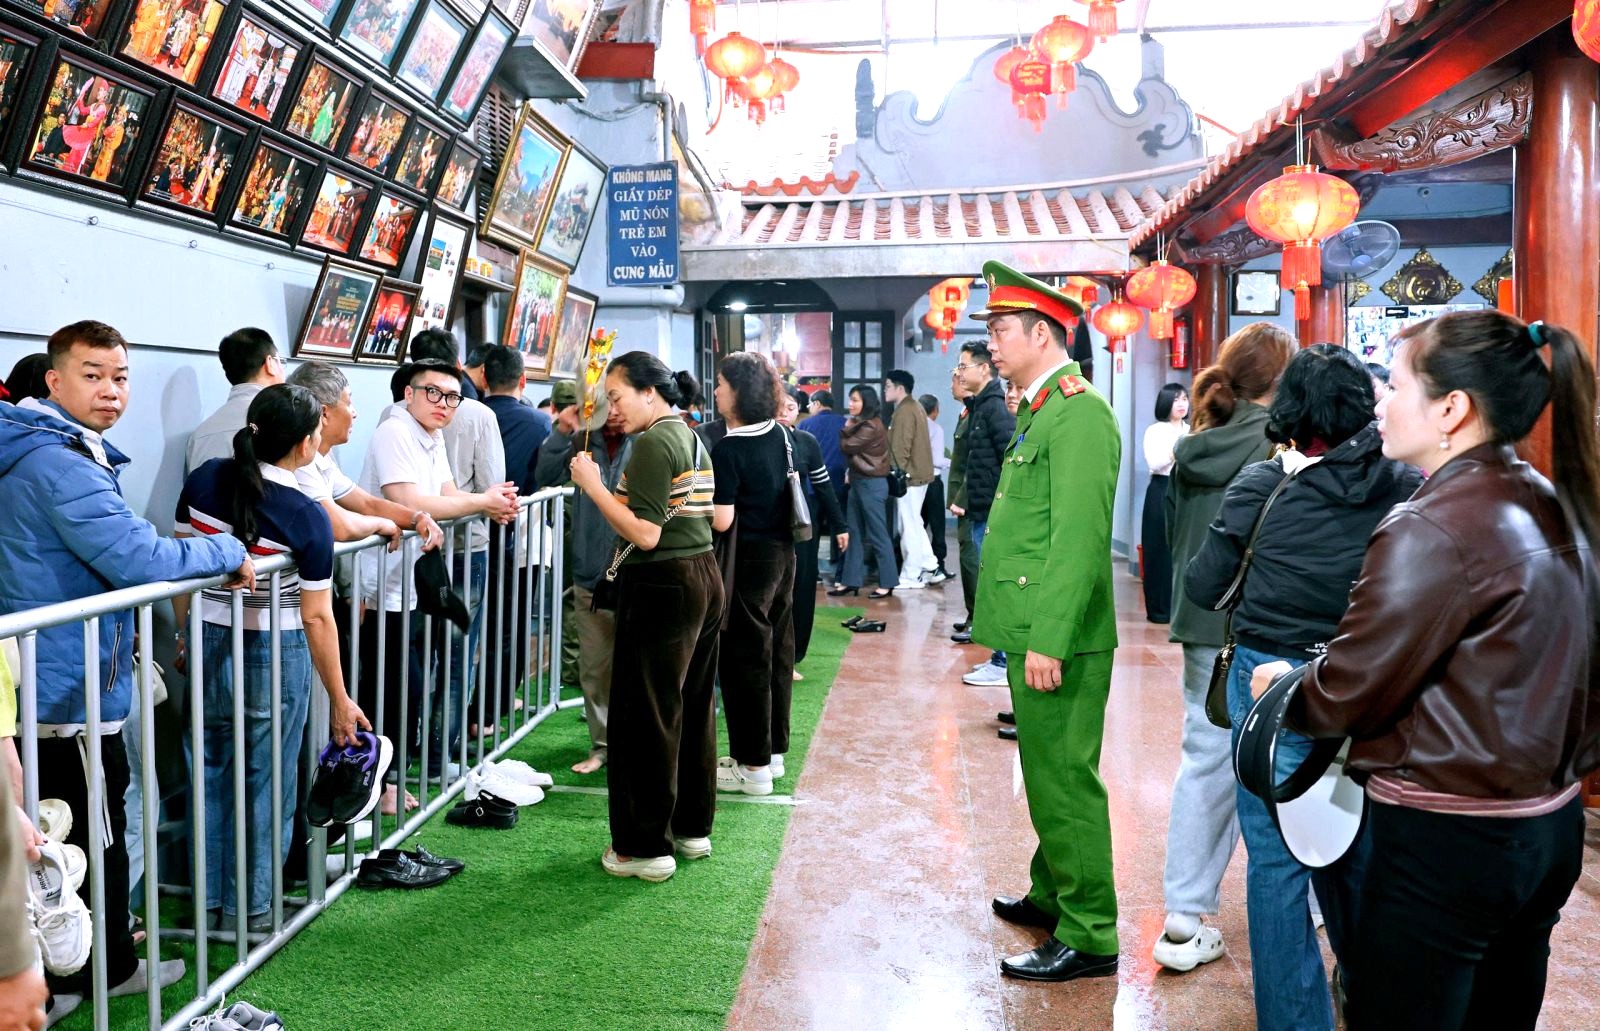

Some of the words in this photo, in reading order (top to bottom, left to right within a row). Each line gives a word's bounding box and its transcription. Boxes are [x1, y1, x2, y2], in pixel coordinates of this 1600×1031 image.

[613, 169, 644, 184] KHÔNG
[646, 168, 672, 182] MANG
[648, 226, 667, 238] EM
[630, 242, 657, 257] VÀO
[613, 266, 645, 279] CUNG
